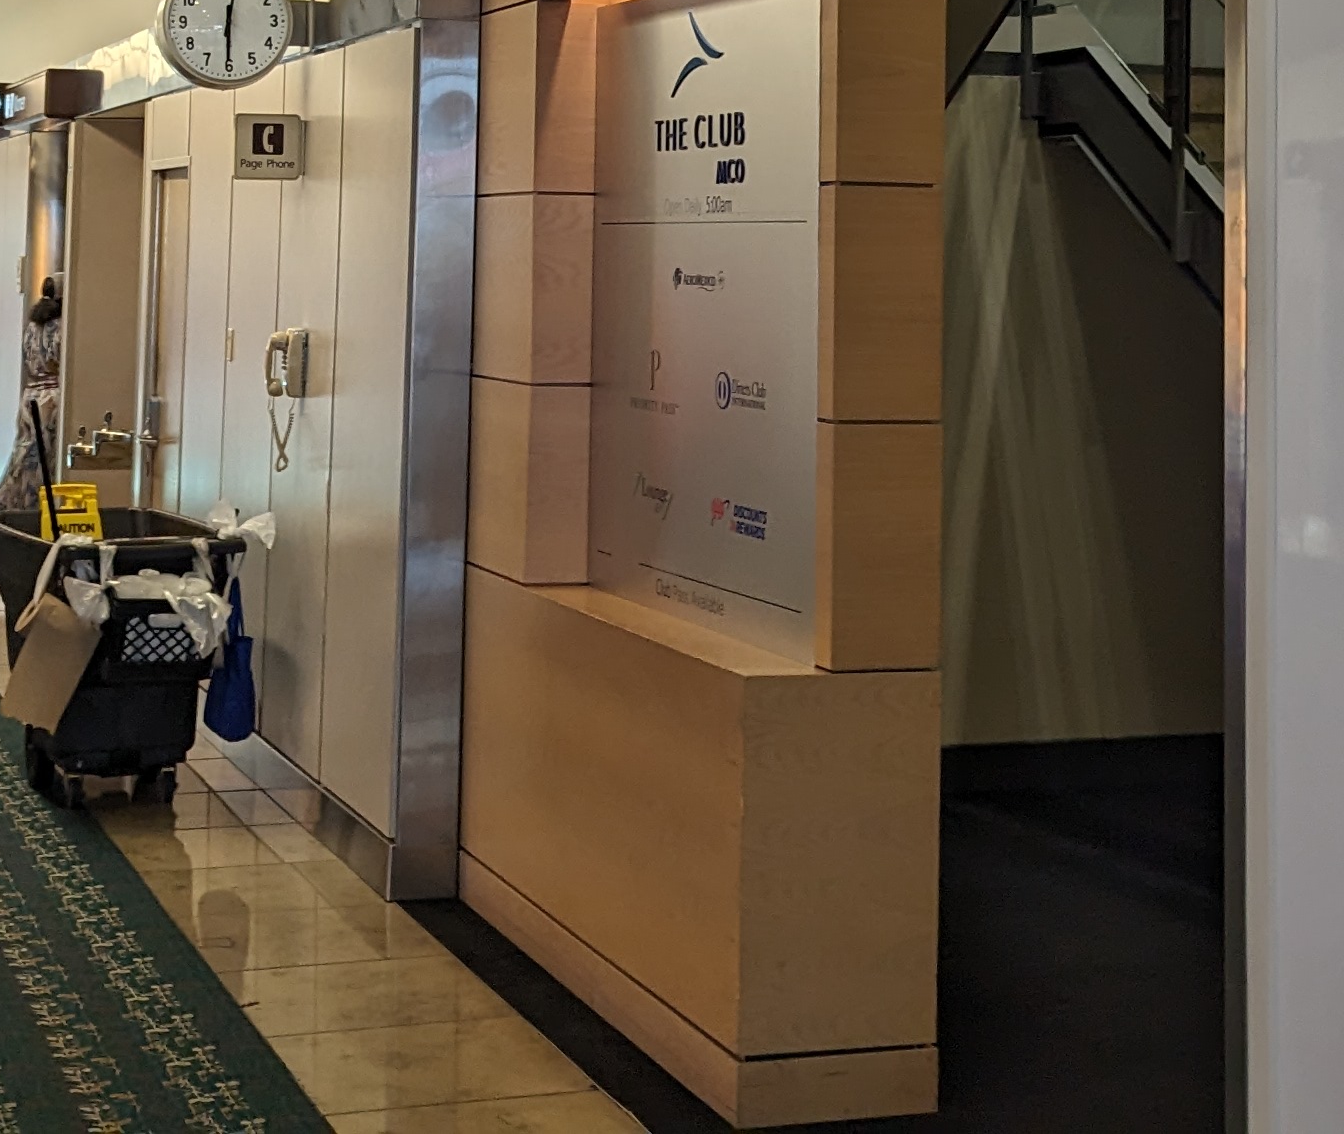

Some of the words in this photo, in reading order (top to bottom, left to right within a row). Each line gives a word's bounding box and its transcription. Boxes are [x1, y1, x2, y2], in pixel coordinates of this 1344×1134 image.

[178, 15, 188, 29] 9
[269, 14, 279, 28] 3
[186, 36, 195, 50] 8
[264, 36, 273, 50] 4
[202, 52, 212, 66] 7
[225, 59, 234, 72] 6
[247, 52, 257, 65] 5
[654, 118, 689, 152] THE
[694, 112, 746, 149] CLUB
[239, 158, 263, 170] Page
[266, 158, 295, 168] Phone
[716, 158, 746, 184] MCO
